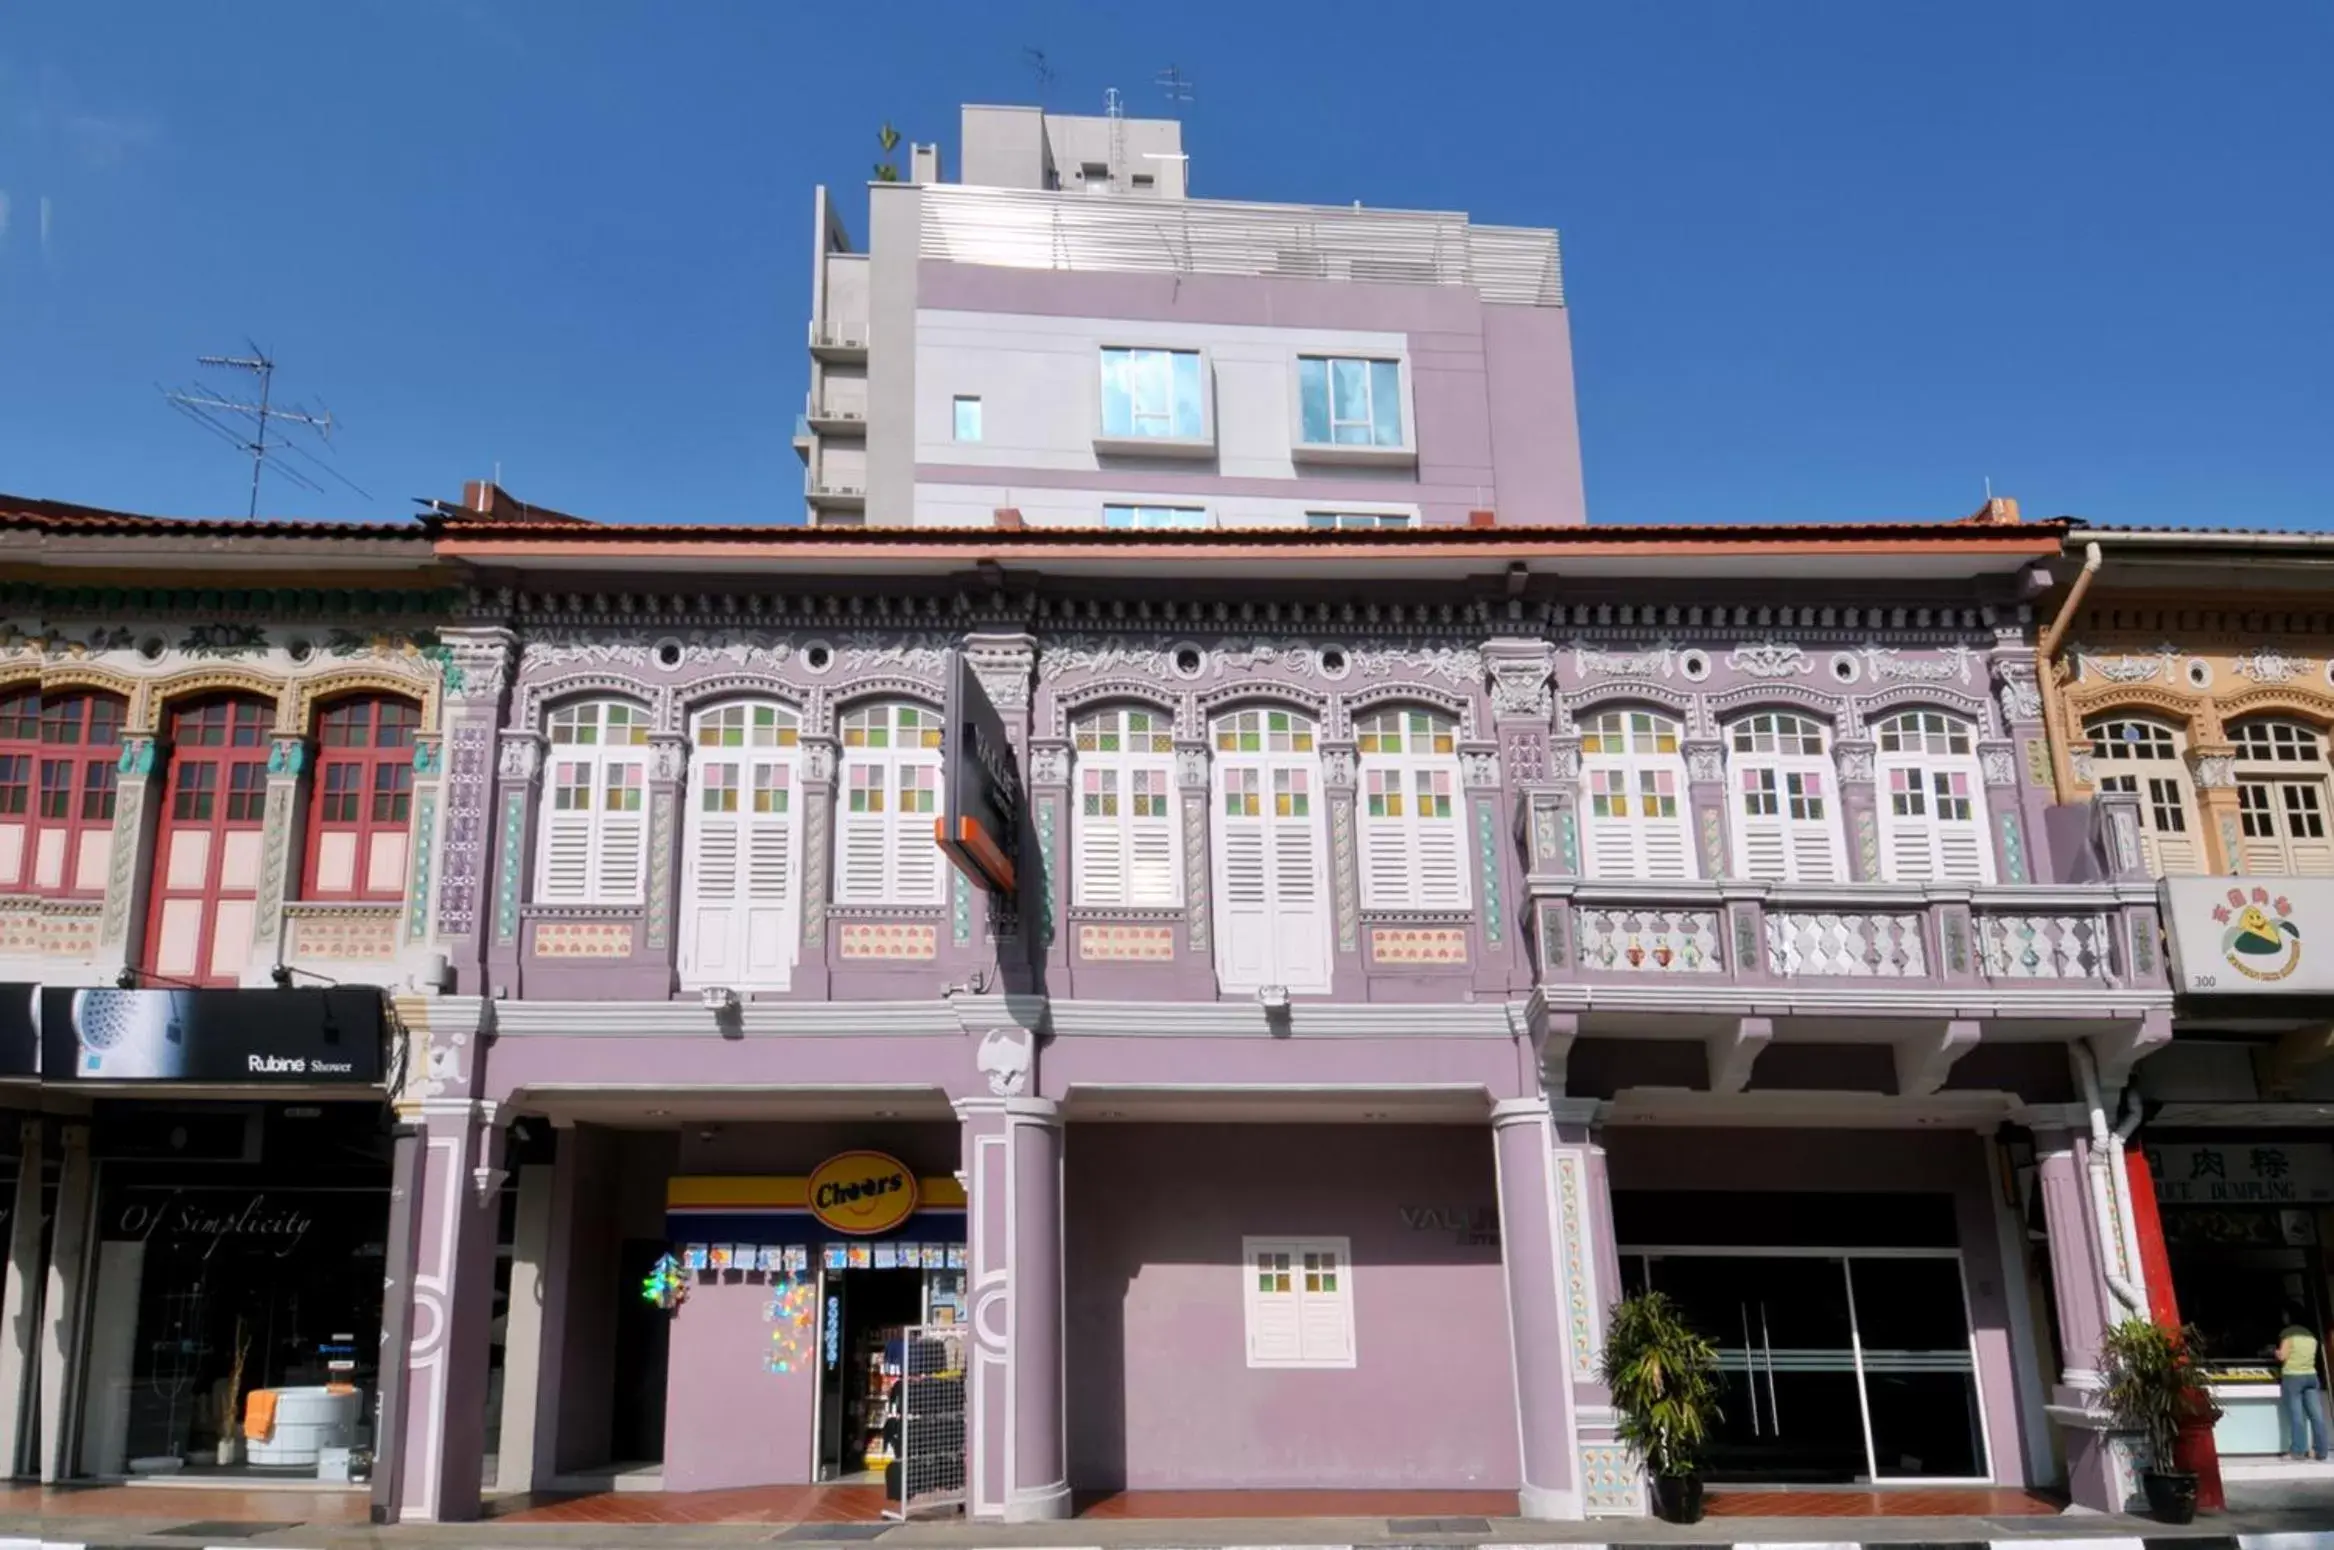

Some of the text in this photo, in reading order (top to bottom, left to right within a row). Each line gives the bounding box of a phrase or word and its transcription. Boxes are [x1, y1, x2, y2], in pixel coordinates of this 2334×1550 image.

[2194, 975, 2217, 988] 300
[248, 1054, 352, 1073] Rubine Shower
[816, 1174, 902, 1209] Cheers
[2209, 1181, 2297, 1201] DUMPLING
[120, 1193, 312, 1261] Of Simplicity
